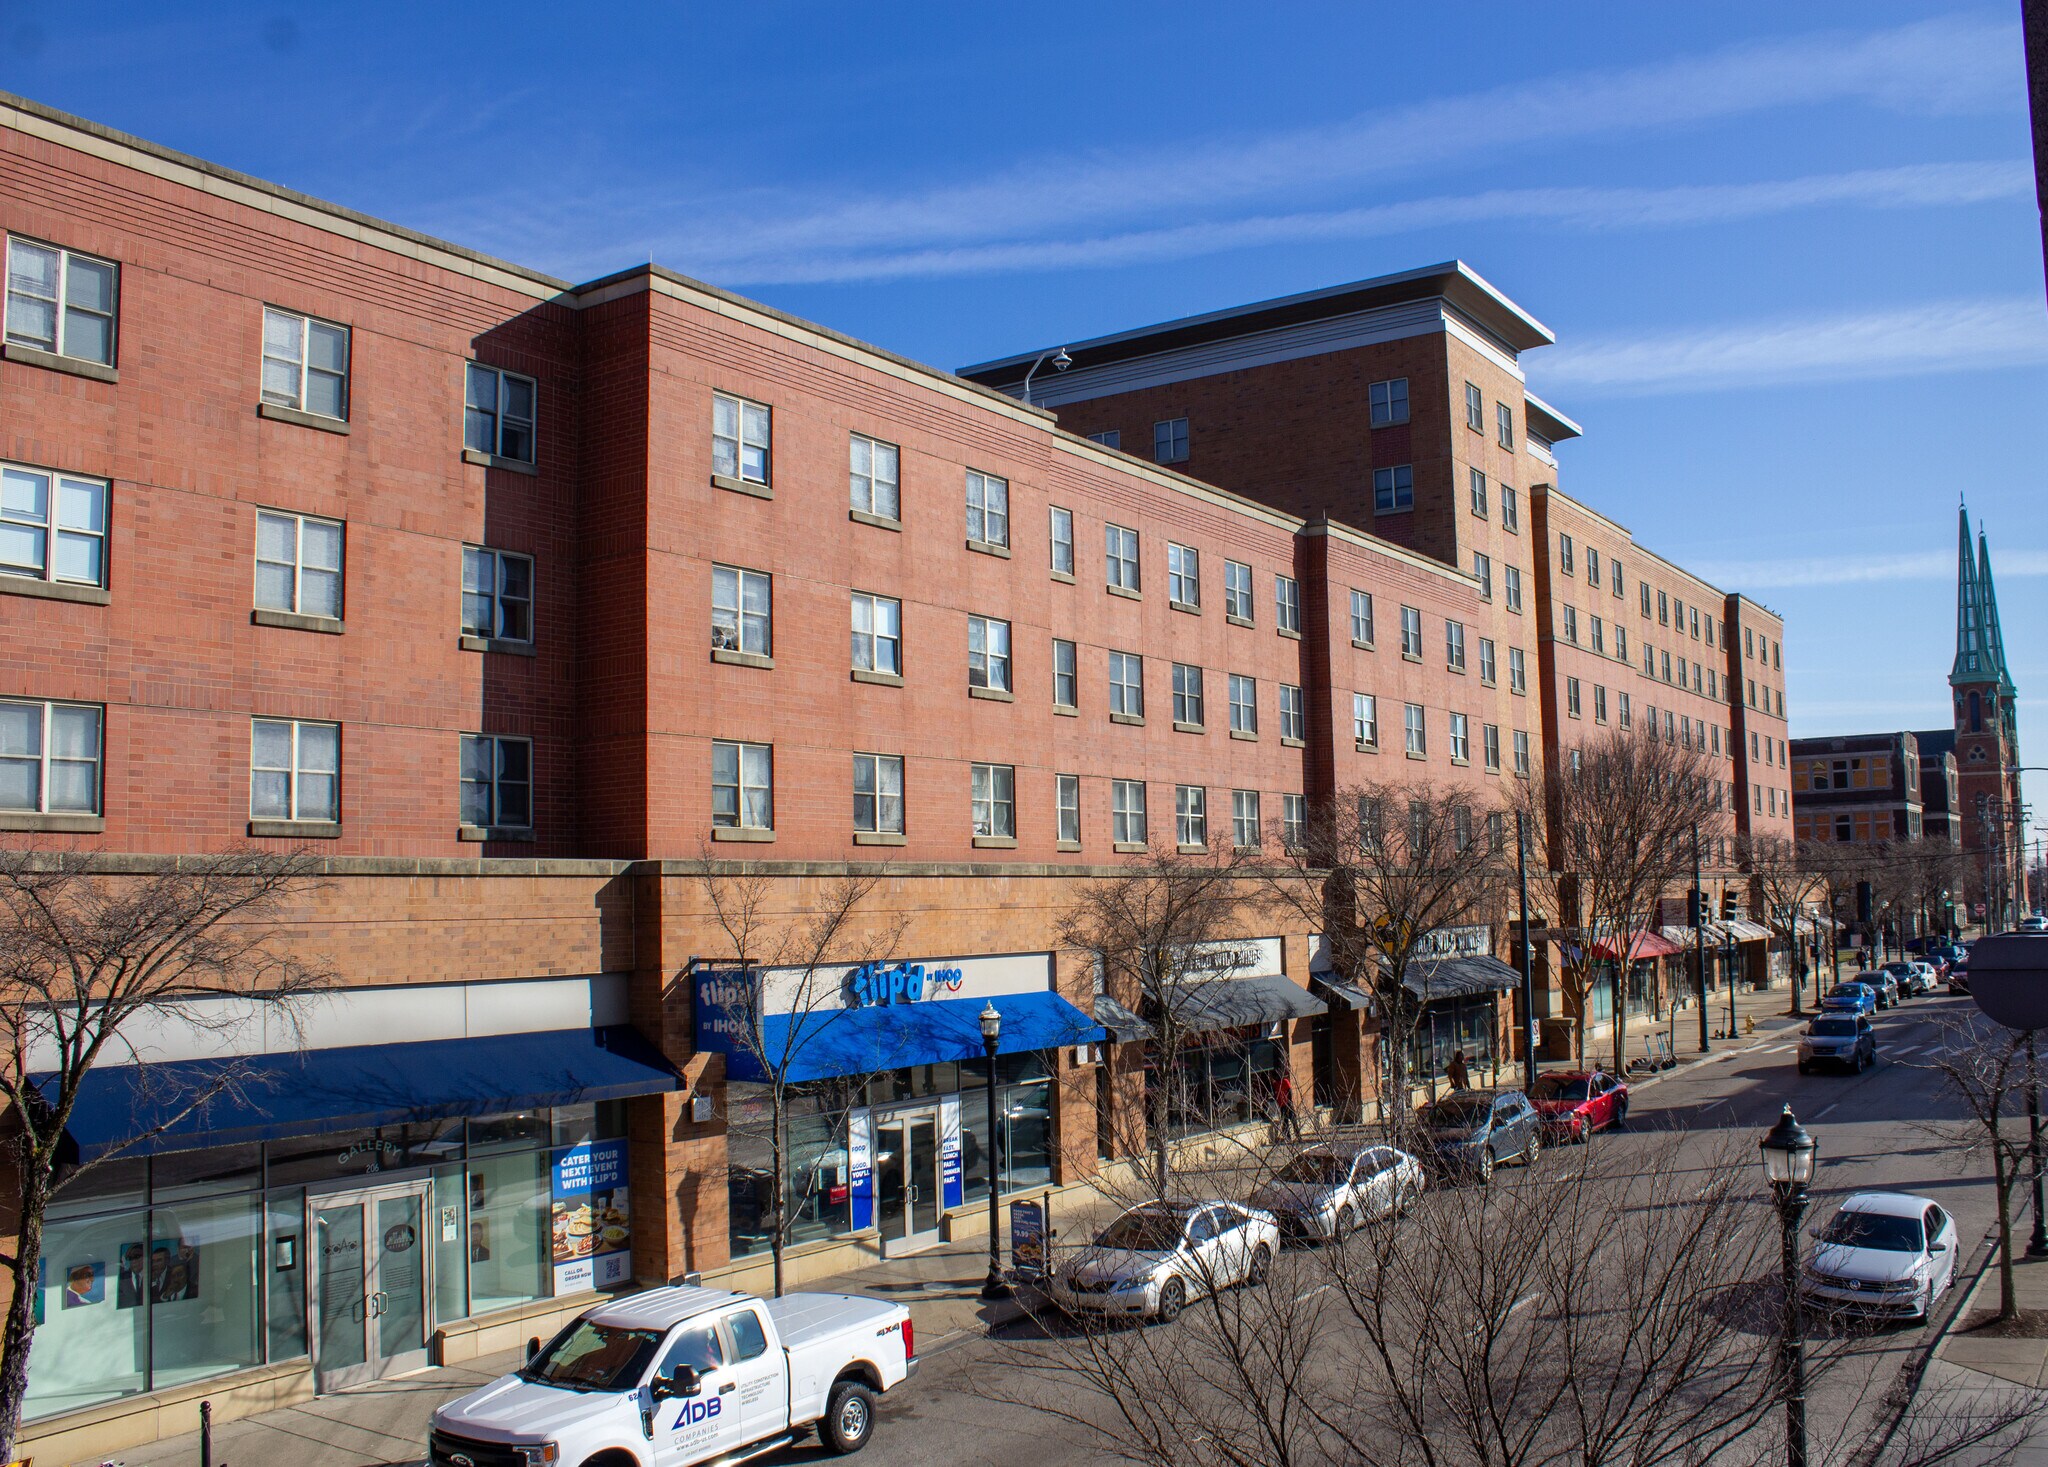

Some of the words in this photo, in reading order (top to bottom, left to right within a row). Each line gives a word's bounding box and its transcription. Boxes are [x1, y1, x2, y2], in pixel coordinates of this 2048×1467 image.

[853, 961, 925, 1006] flip'd
[935, 968, 963, 986] IHOP
[703, 1022, 711, 1030] BY
[338, 1140, 402, 1165] GALLERY
[560, 1154, 590, 1167] CATER
[592, 1149, 618, 1162] YOUR
[366, 1163, 379, 1174] 206
[561, 1166, 587, 1178] NEXT
[588, 1160, 618, 1174] EVENT
[561, 1177, 588, 1190] WITH
[589, 1171, 618, 1185] FLIP'D
[564, 1273, 580, 1282] ORDER
[754, 1373, 779, 1385] CONSTRUCTION
[741, 1389, 764, 1400] TECHNOLOGY
[672, 1396, 721, 1430] ADB
[674, 1423, 719, 1445] COMPANIES
[676, 1432, 719, 1451] www.adb-us.com
